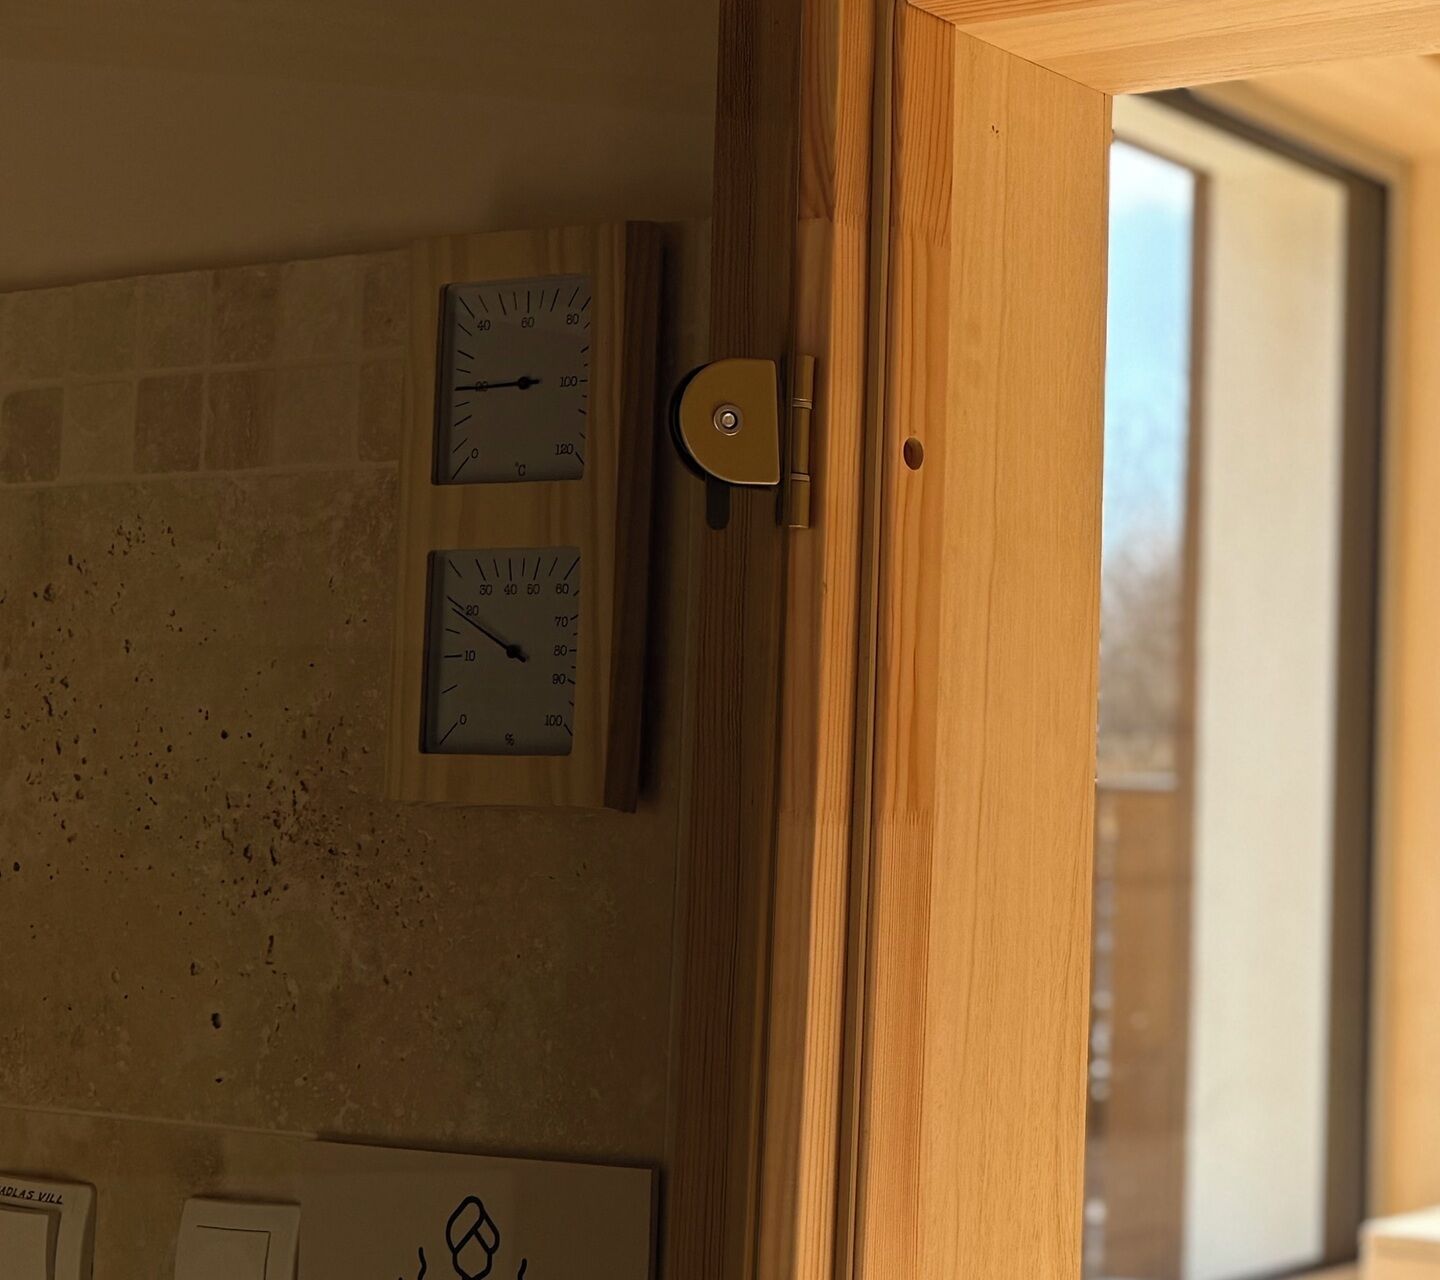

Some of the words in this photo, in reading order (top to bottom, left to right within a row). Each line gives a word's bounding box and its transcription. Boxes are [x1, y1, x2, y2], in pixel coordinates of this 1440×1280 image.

[477, 319, 491, 331] 40
[521, 317, 535, 329] 60
[566, 313, 580, 325] 80
[559, 375, 578, 388] 100
[471, 448, 479, 459] 0
[555, 443, 574, 456] 120
[479, 583, 493, 596] 30
[503, 583, 518, 596] 40
[527, 583, 540, 595] 50
[555, 583, 569, 595] 60
[466, 604, 480, 617] 20
[554, 616, 568, 628] 70
[464, 650, 476, 662] 10
[553, 645, 568, 657] 80
[552, 673, 566, 685] 90
[459, 714, 467, 726] 0
[544, 714, 563, 727] 100
